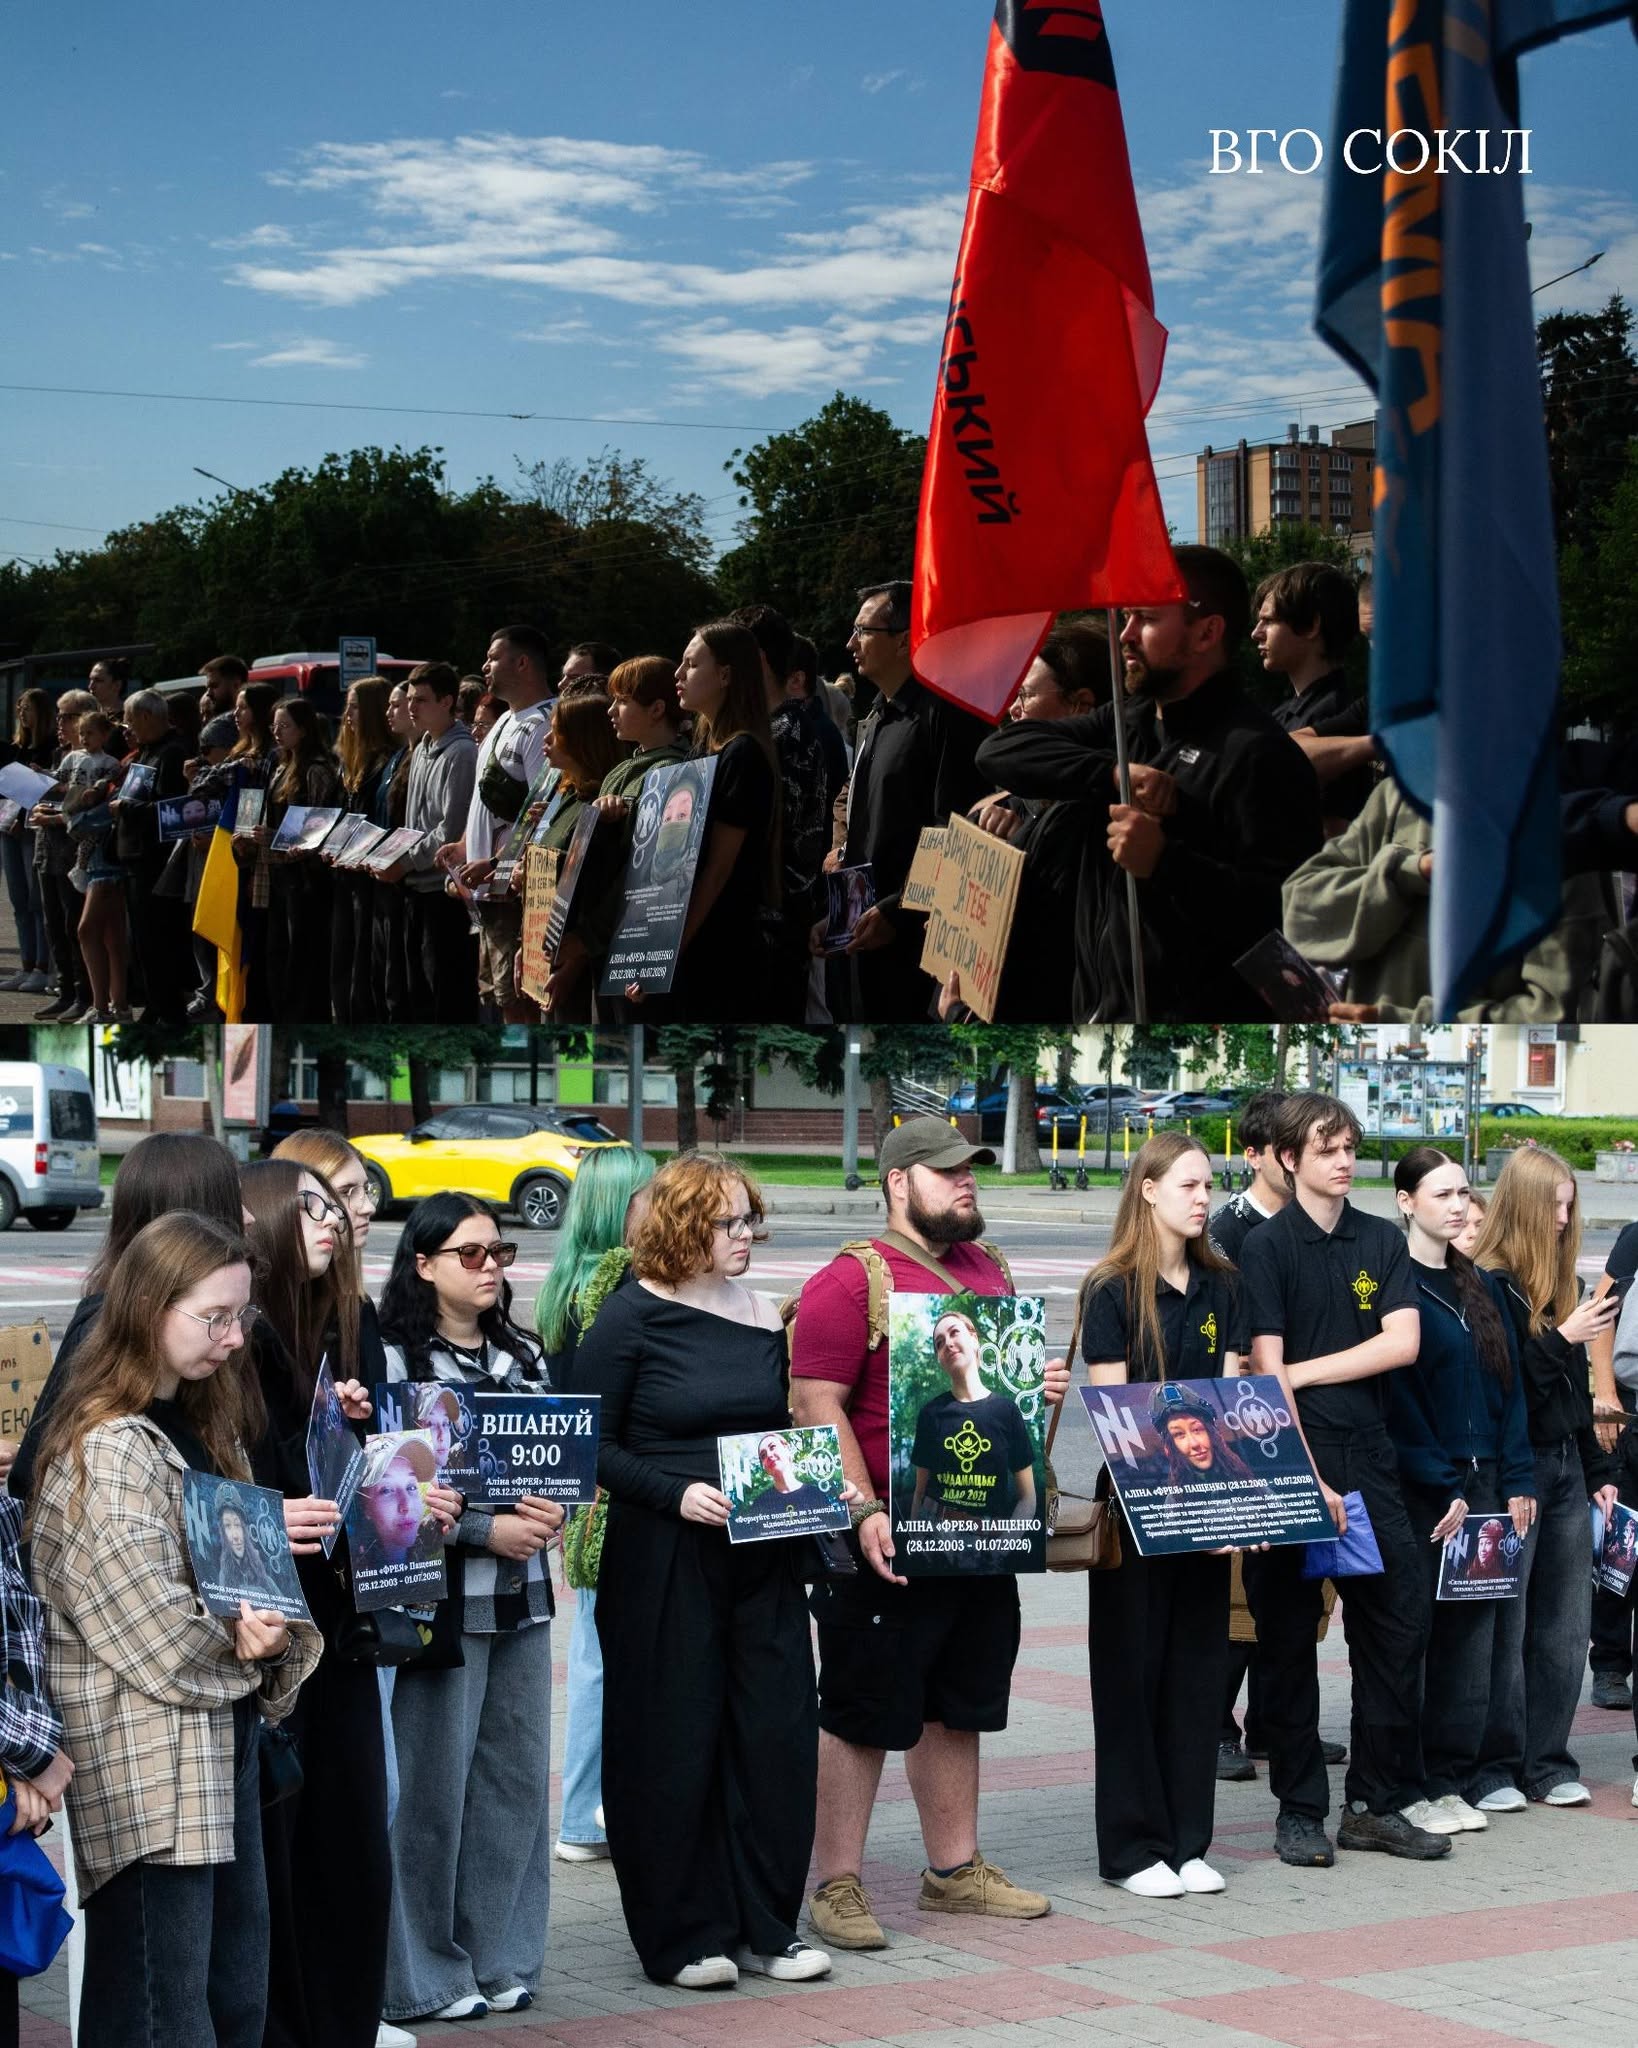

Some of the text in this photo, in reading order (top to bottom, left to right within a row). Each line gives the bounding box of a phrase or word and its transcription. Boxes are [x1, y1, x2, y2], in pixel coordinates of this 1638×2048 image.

[966, 879, 990, 927] ТЕБЕ
[481, 1408, 593, 1436] ВШАНУЙ
[511, 1444, 561, 1466] 9:00
[486, 1477, 581, 1487] Аліна «ФРЕЯ» Пащенко
[488, 1487, 531, 1498] (28.12.2003
[538, 1487, 580, 1498] 01.07.2026)
[1124, 1489, 1152, 1499] АЛІНА
[1153, 1486, 1183, 1496] «ФРЕЯ»
[1184, 1482, 1227, 1494] ПАЩЕНКО
[1227, 1479, 1268, 1492] (28.12.2003
[1274, 1475, 1314, 1486] 01.07.2026)
[896, 1519, 1041, 1533] АЛІНА «ФРЕЯ» ПАЩЕНКО
[906, 1540, 965, 1556] (28.12.2003
[975, 1538, 1032, 1554] 01.07.2026)
[355, 1559, 442, 1579] Аліна «ФРЕЯ» Пащенко
[358, 1578, 398, 1593] (28.12.2003
[404, 1570, 441, 1584] 01.07.2026)
